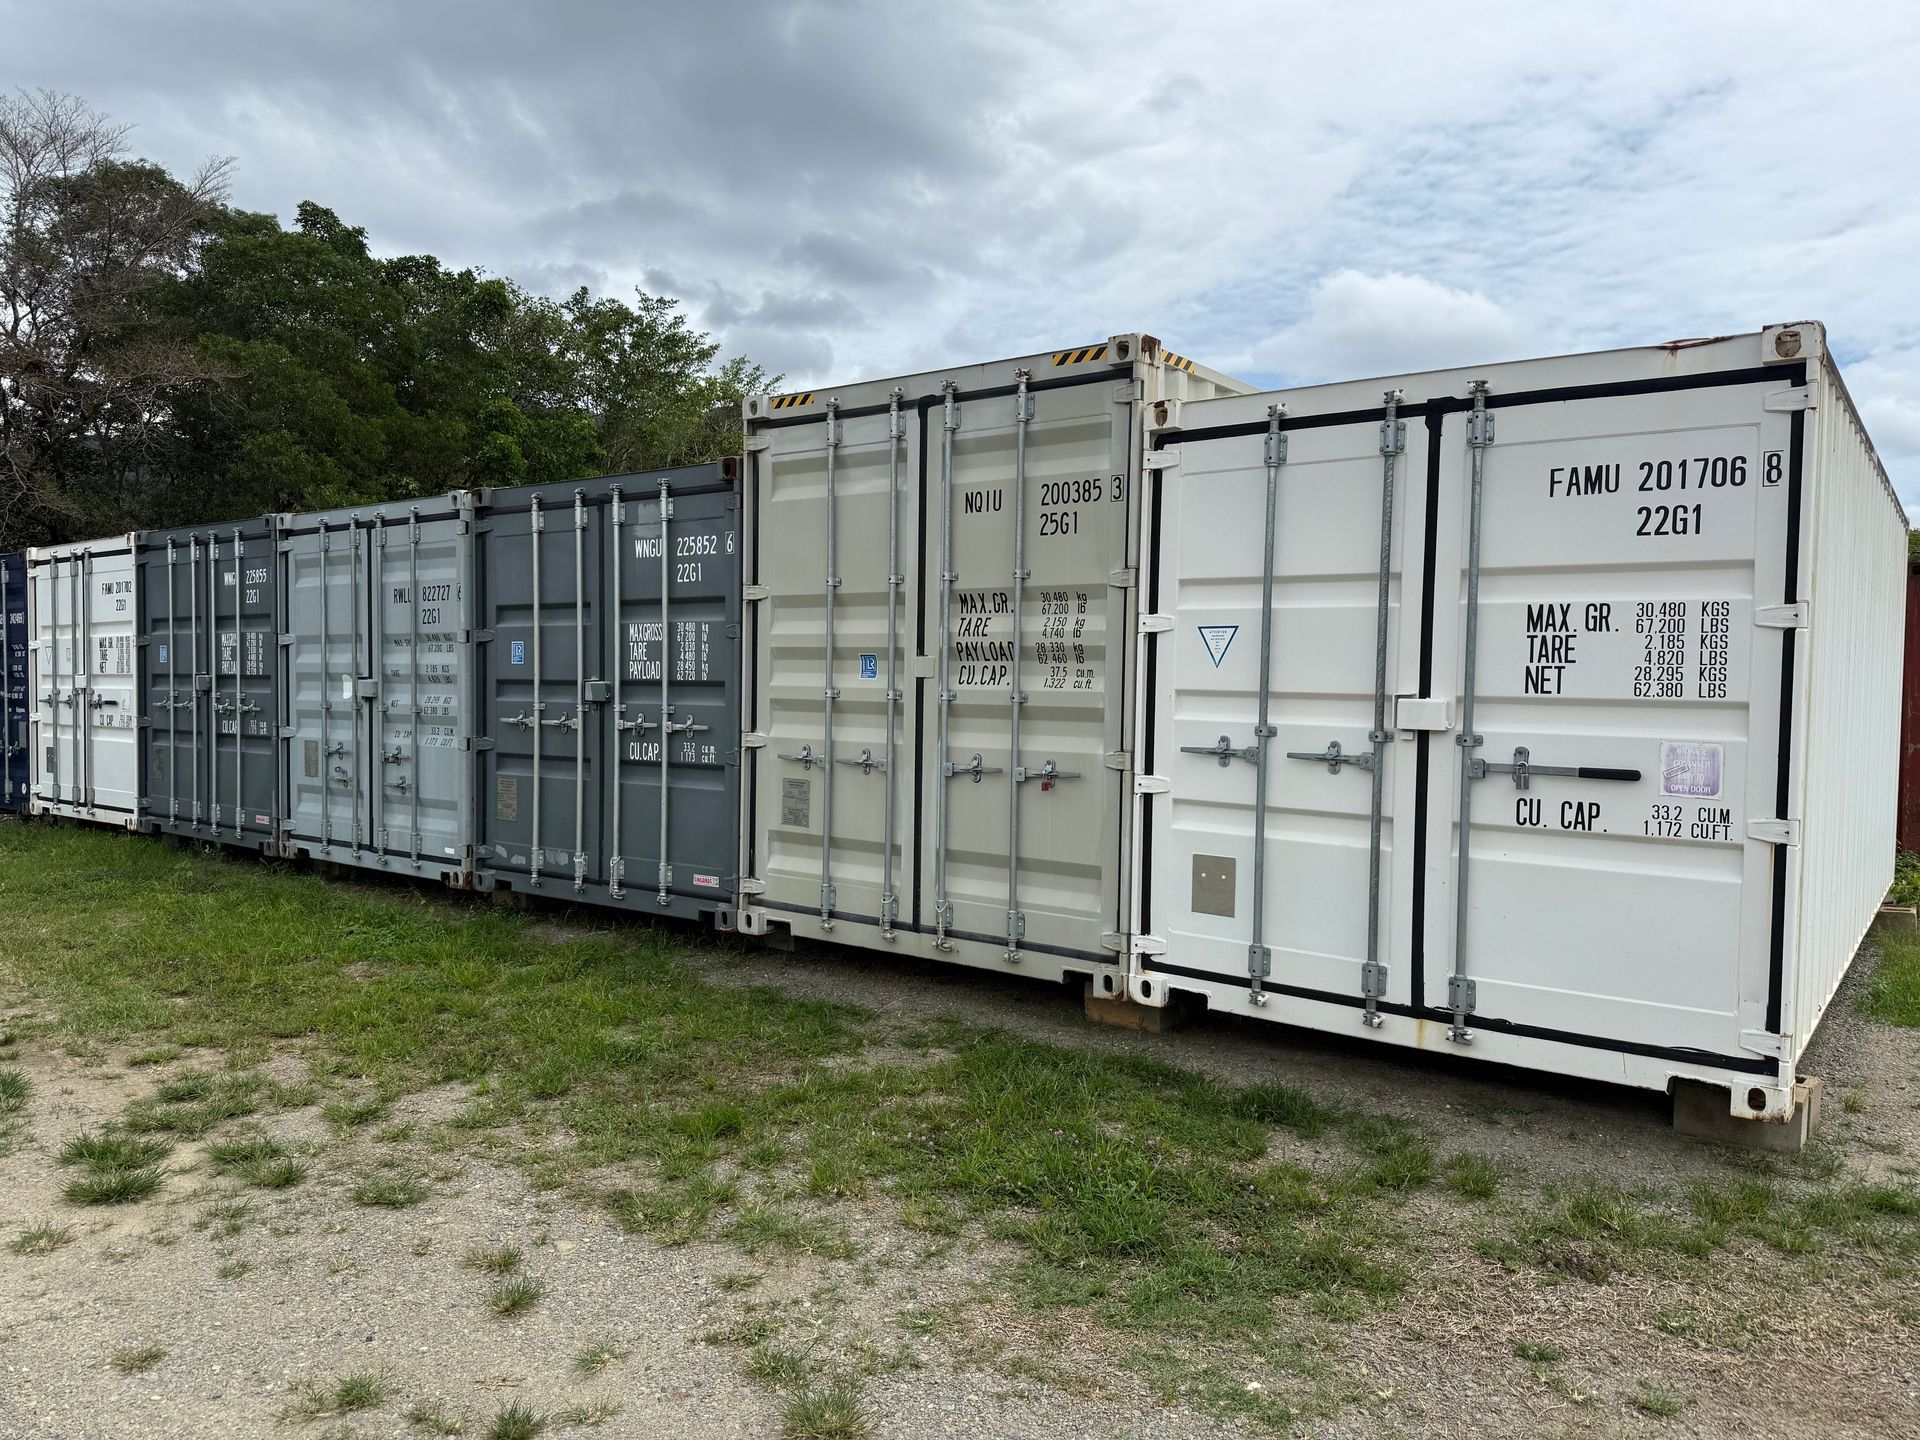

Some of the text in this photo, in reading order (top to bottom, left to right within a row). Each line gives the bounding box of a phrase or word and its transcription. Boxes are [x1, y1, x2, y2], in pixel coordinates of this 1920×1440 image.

[1549, 453, 1783, 498] FAMU 201706 8
[965, 477, 1122, 514] NQIU 200385 3
[1040, 511, 1078, 536] 25G1
[1636, 503, 1702, 536] 22G1
[635, 533, 734, 558] WNGU 225852 6
[245, 568, 267, 584] 225855
[677, 562, 702, 582] 22G1
[422, 584, 451, 602] 822727
[1076, 591, 1087, 604] kg
[422, 607, 441, 625] 22G1
[1077, 603, 1086, 614] lb
[1526, 603, 1577, 633] MAX.
[1584, 602, 1620, 633] GR.
[1702, 601, 1730, 617] KGS
[958, 617, 992, 637] TARE
[1075, 617, 1085, 629] kg
[1073, 627, 1082, 638] lb
[1701, 618, 1729, 633] LBS
[629, 642, 648, 661] TARE
[1073, 642, 1084, 655] kg
[1527, 634, 1577, 663] TARE
[1700, 634, 1728, 650] KGS
[1074, 653, 1085, 664] lb
[1699, 650, 1728, 666] LBS
[629, 660, 661, 680] PAYLOAD
[1050, 666, 1067, 678] 37.5
[1524, 665, 1566, 695] NET
[1698, 666, 1727, 682] KGS
[1698, 682, 1726, 698] LBS
[1670, 784, 1711, 794] OPEN DOOR
[1515, 798, 1733, 833] CU. CAP. 33.2 CU.M.
[1691, 823, 1733, 841] CU.FT.
